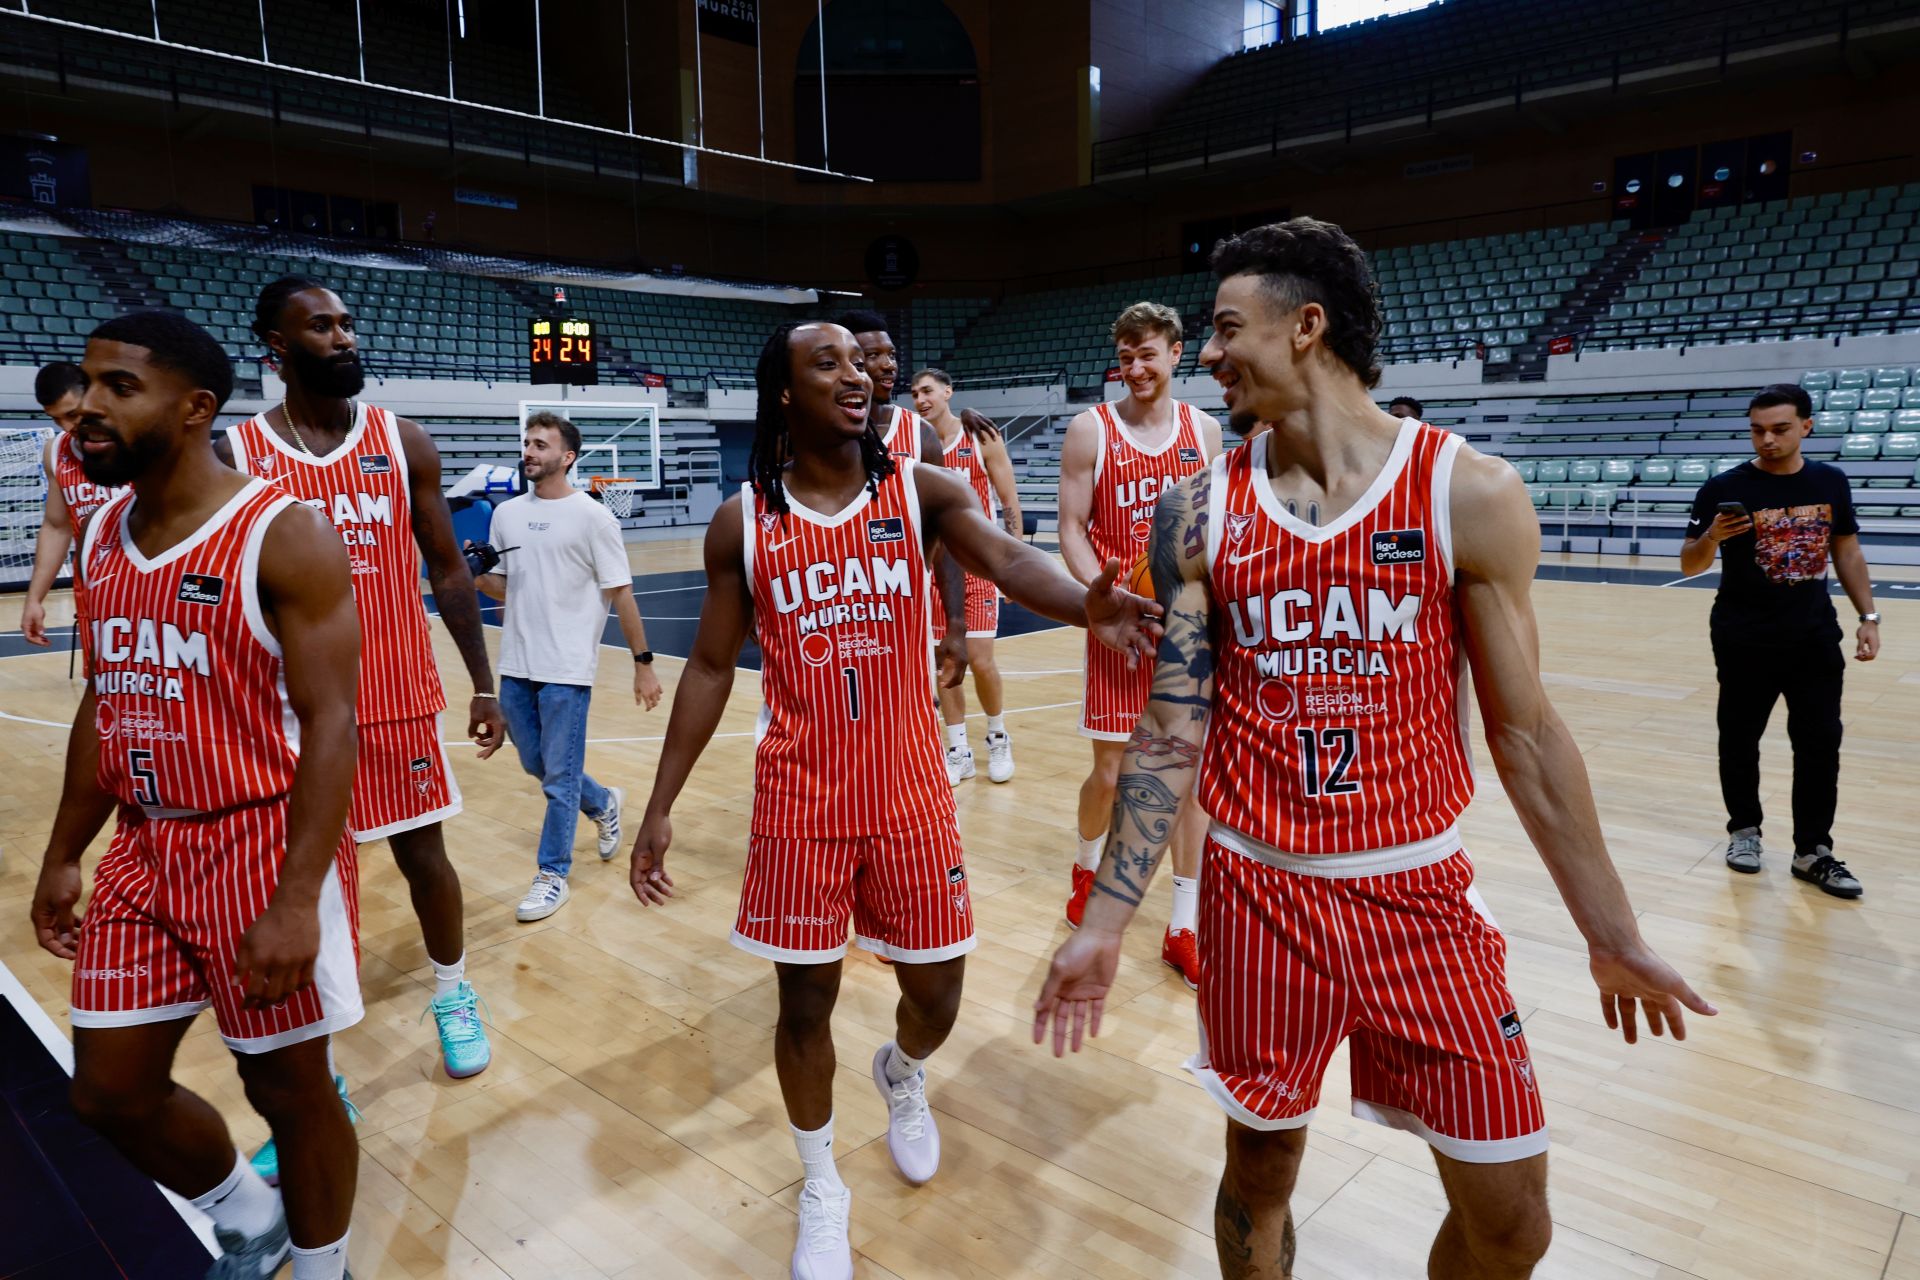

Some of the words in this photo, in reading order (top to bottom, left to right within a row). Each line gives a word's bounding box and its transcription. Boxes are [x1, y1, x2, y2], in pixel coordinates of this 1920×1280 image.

[532, 338, 551, 363] 24
[560, 337, 590, 361] 24
[1116, 474, 1188, 509] UCA
[304, 491, 392, 526] AM
[341, 529, 377, 546] CIA
[870, 526, 886, 535] liga
[872, 531, 902, 540] endesa
[1376, 541, 1397, 552] liga
[1376, 549, 1422, 561] endesa
[182, 582, 200, 592] liga
[770, 556, 912, 614] UCAM
[180, 590, 219, 602] endesa
[798, 601, 893, 635] MURCIA
[1227, 585, 1421, 648] UCAM
[840, 637, 877, 649] REGIÓN
[840, 650, 852, 659] DE
[855, 645, 893, 657] MURCIA
[1256, 647, 1391, 679] MURCIA
[843, 666, 860, 721] 1
[1305, 692, 1363, 706] REGIÓN
[1306, 707, 1326, 716] DE
[1330, 702, 1389, 716] MURCIA
[121, 728, 136, 738] DE
[137, 730, 187, 742] MURCIA
[1295, 728, 1361, 797] 12
[127, 748, 164, 809] 5
[1504, 1021, 1520, 1036] acb
